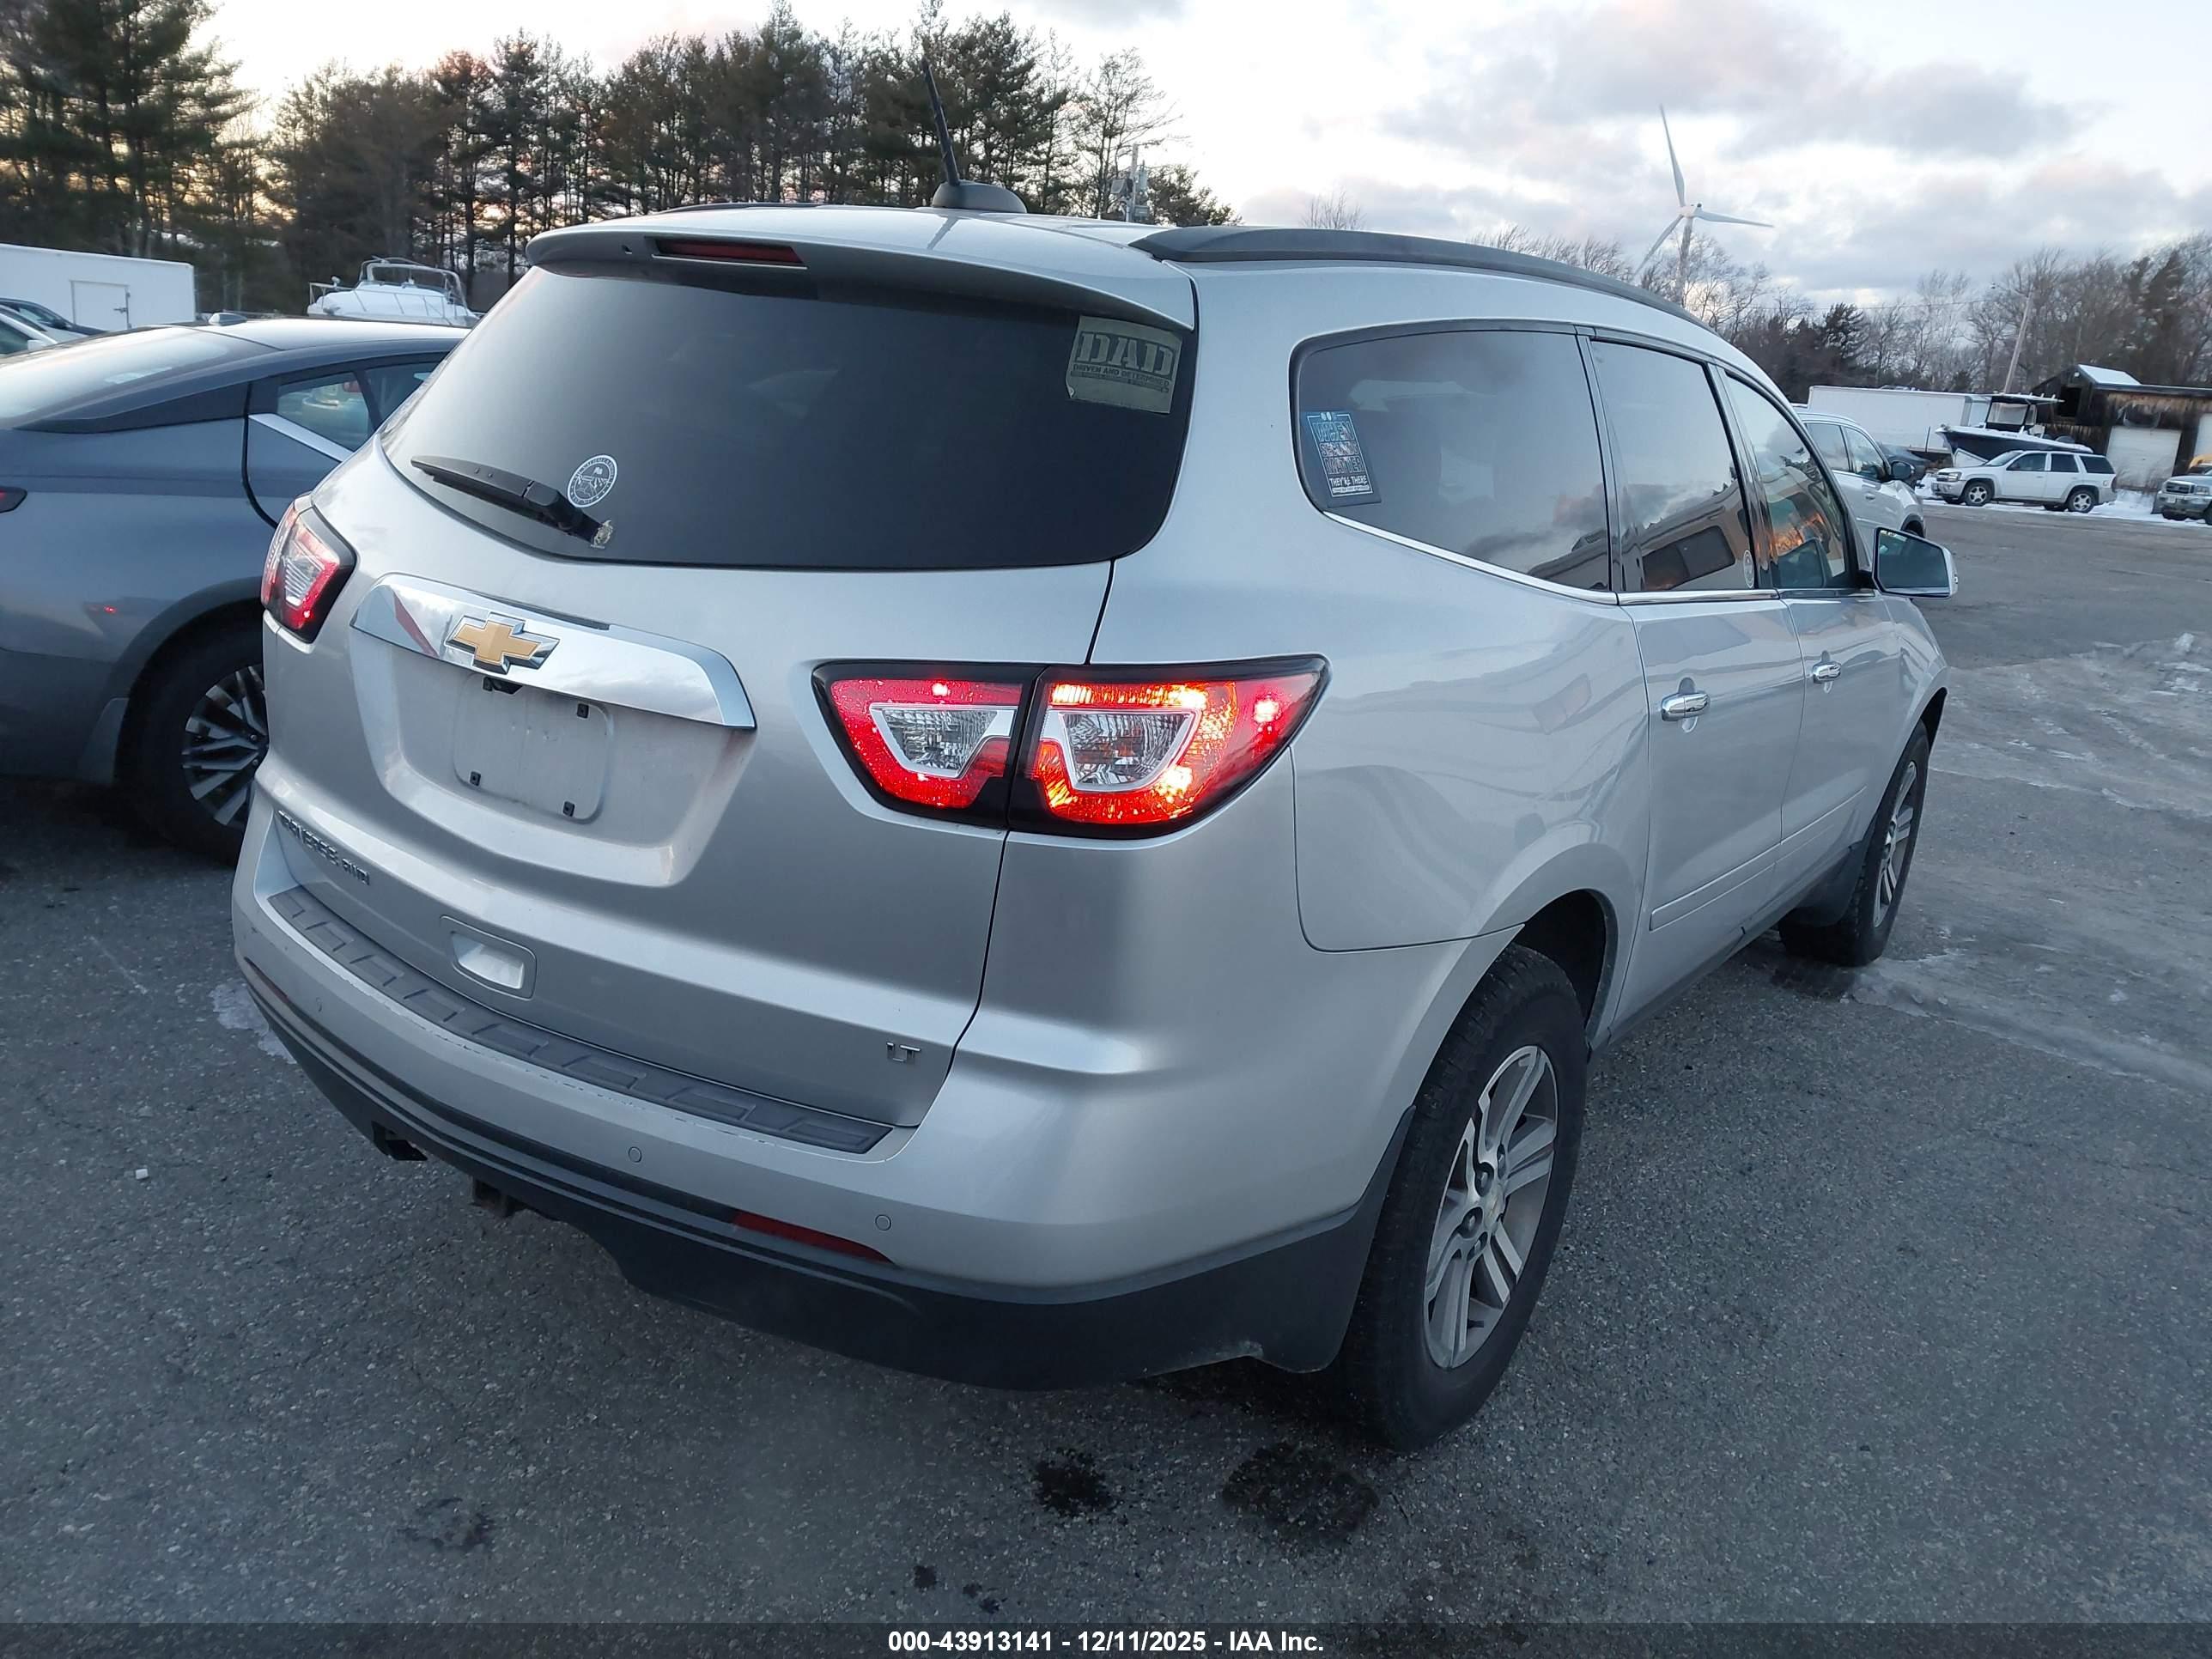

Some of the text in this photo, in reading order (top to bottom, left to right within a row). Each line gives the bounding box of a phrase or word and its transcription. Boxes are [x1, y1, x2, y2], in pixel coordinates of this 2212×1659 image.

[1076, 332, 1174, 376] DAD
[1103, 367, 1120, 376] AND
[1351, 475, 1368, 485] THERE
[277, 810, 339, 866] TRAVERSE
[886, 1041, 921, 1065] LT
